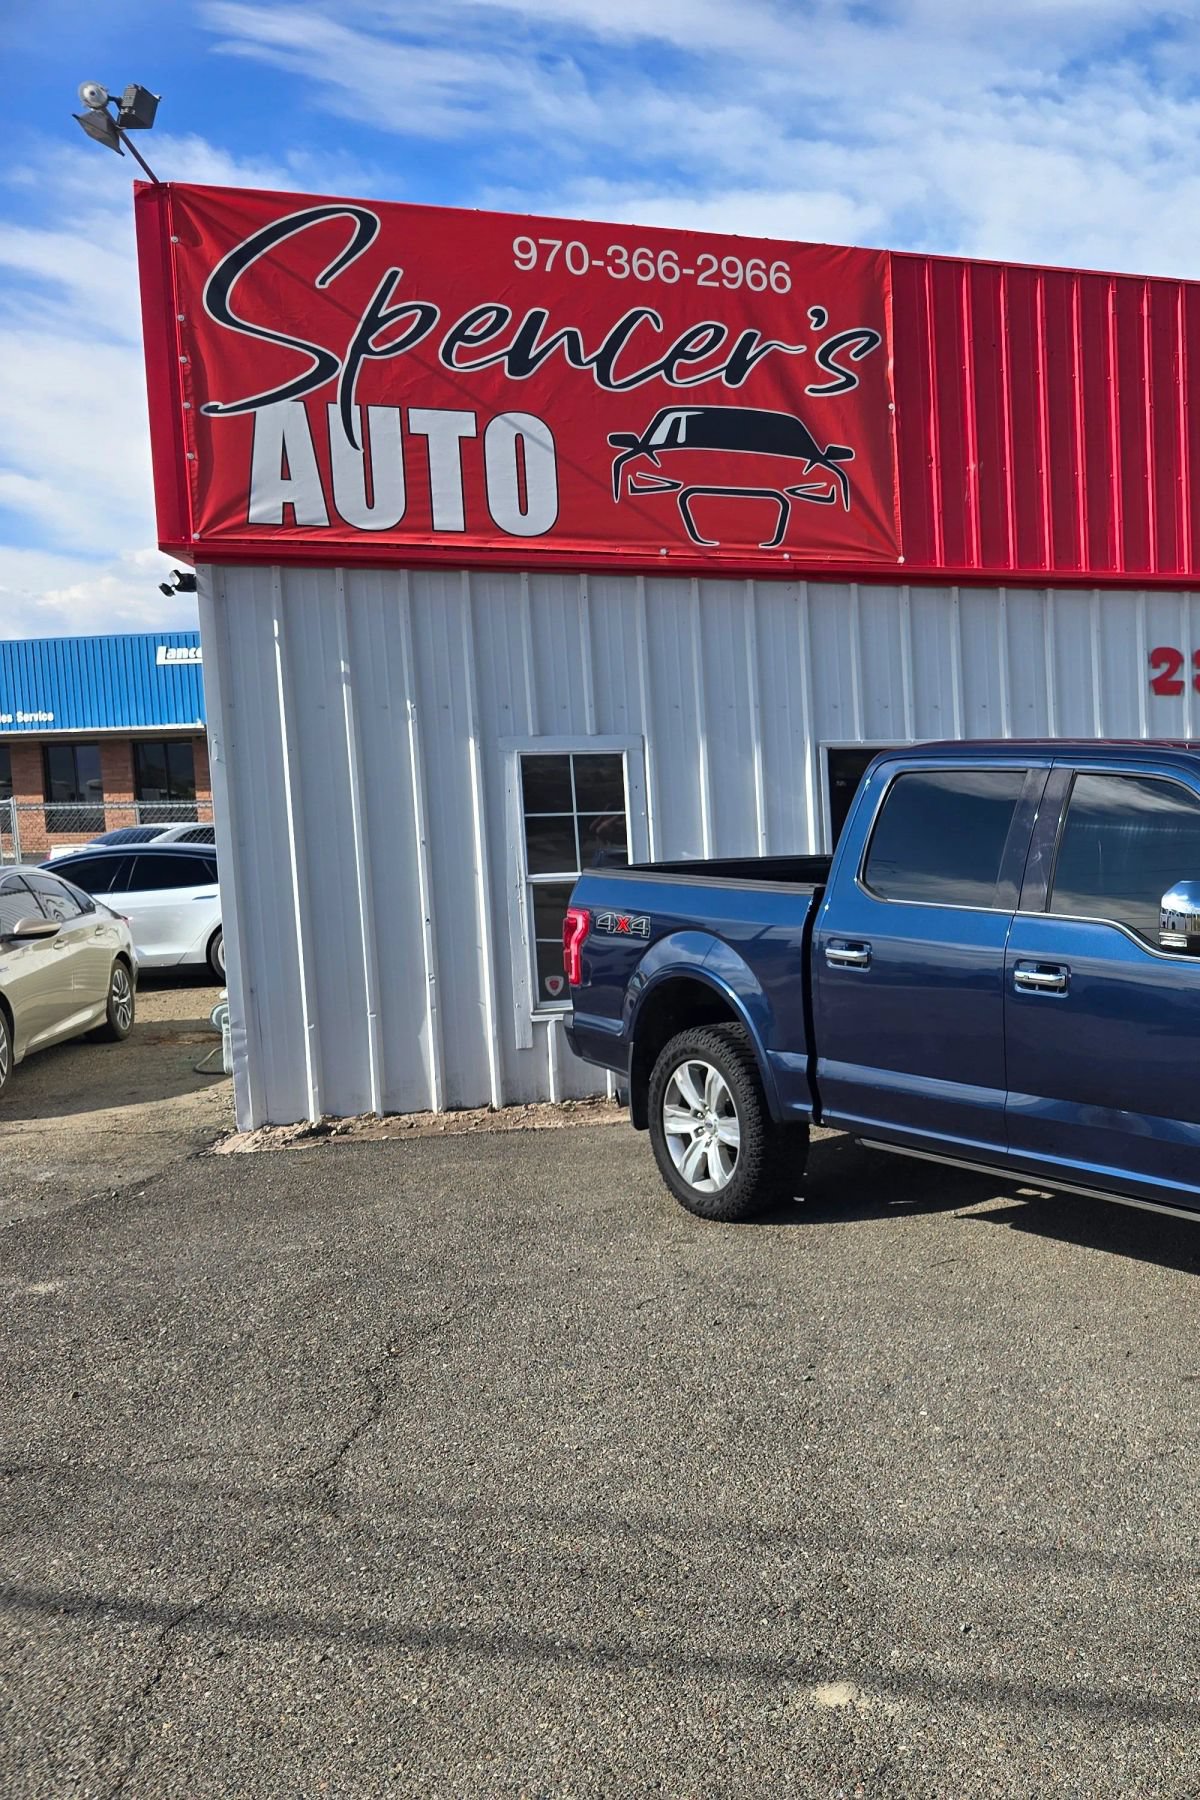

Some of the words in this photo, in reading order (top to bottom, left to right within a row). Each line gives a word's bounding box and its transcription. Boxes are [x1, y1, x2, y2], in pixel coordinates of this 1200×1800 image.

[511, 236, 792, 294] 970-366-2966
[201, 204, 882, 453] Spencer's
[247, 400, 560, 537] AUTO
[16, 710, 54, 723] Service
